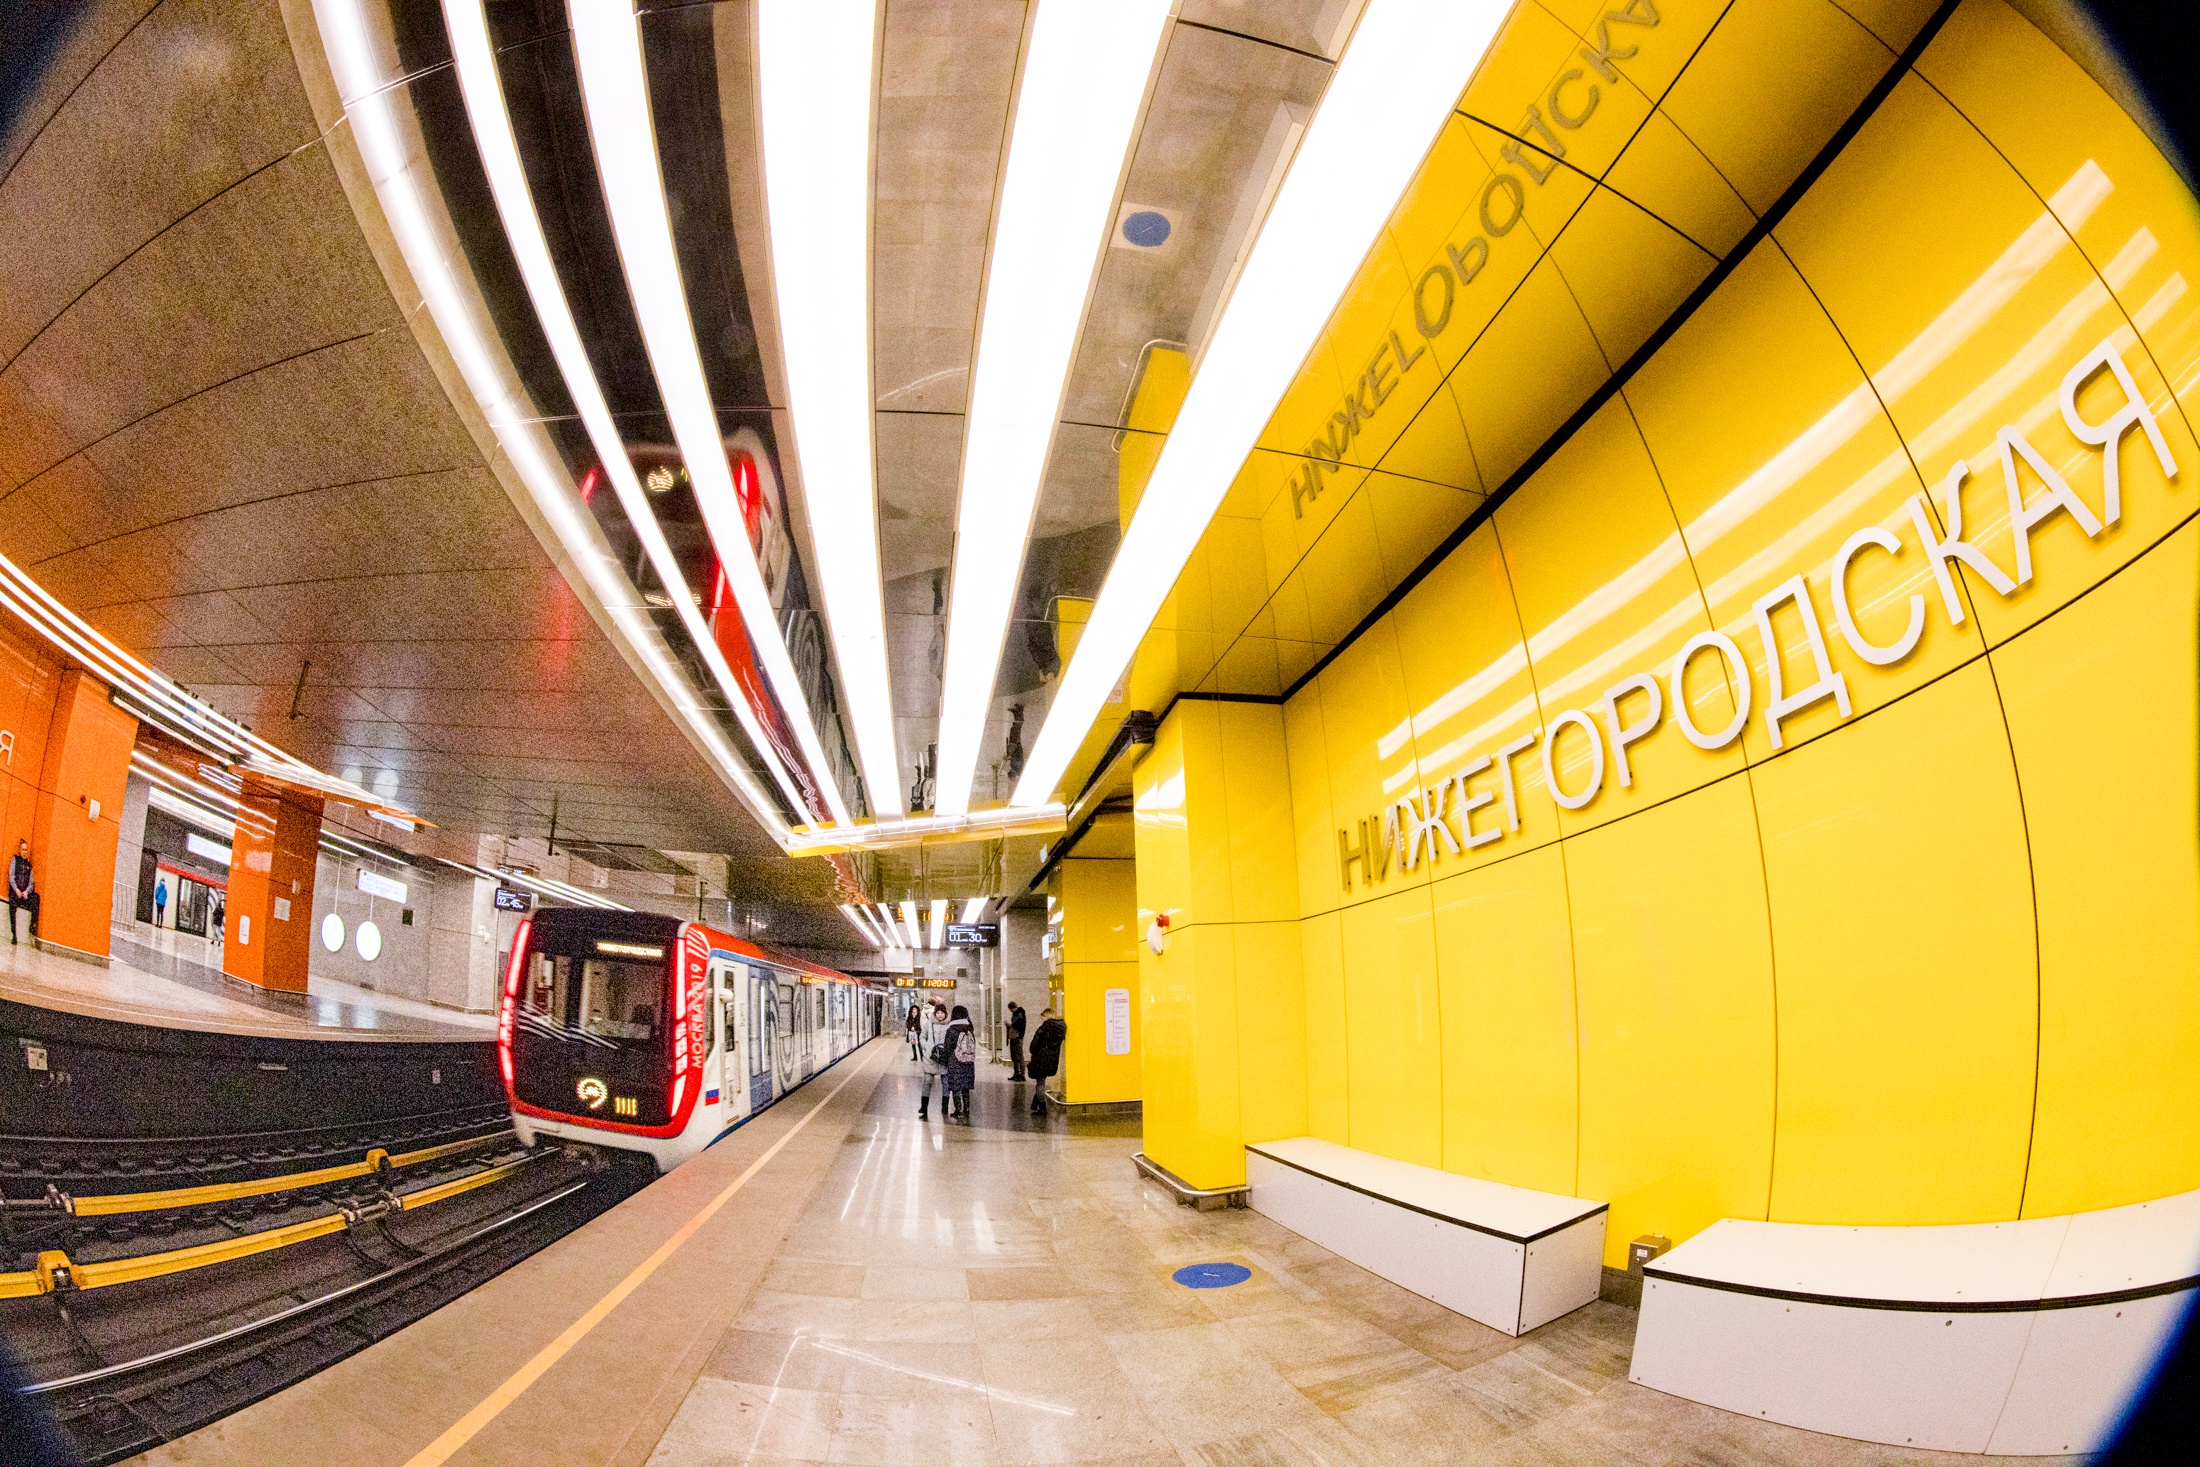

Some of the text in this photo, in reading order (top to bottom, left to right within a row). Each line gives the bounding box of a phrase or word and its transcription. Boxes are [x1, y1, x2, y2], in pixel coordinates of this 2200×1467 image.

[1337, 337, 2179, 892] НИЖЕГОРОДСКАЯ
[948, 933, 961, 942] 01
[968, 933, 982, 942] 30
[896, 978, 915, 987] 0:10
